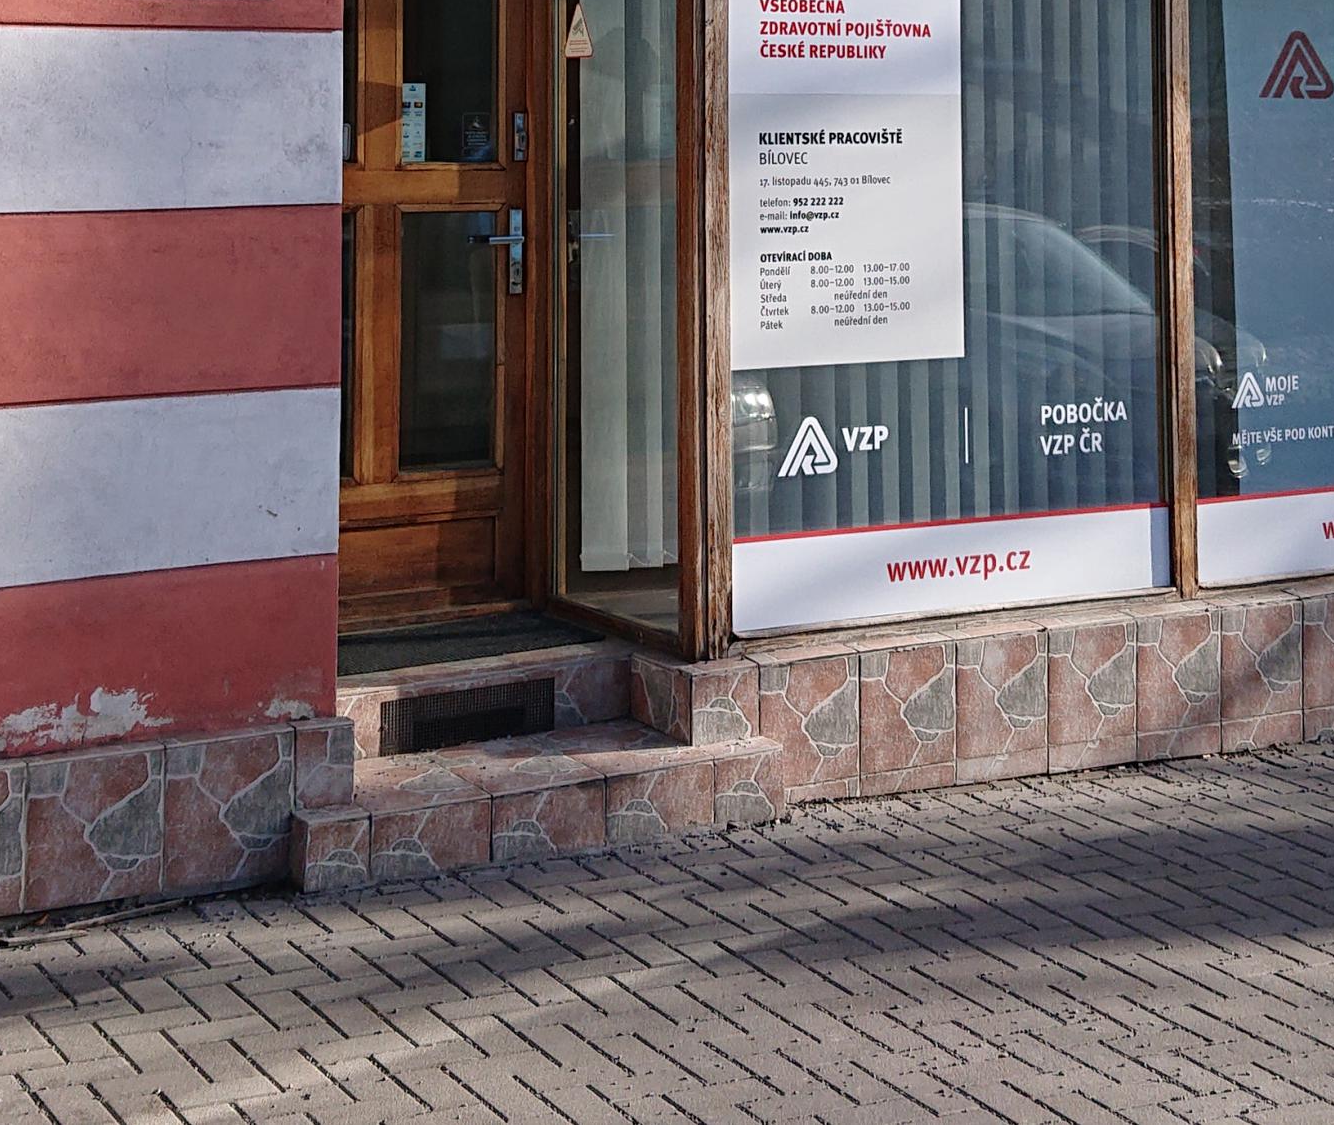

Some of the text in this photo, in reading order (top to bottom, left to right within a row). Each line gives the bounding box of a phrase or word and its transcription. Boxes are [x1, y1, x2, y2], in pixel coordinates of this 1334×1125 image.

[760, 19, 931, 39] ZDRAVOTNÍ POJIŠŤOVNA
[760, 40, 887, 59] ČESKÉ REPUBLIKY
[759, 128, 903, 145] KLIENTSKÉ PRACOVIŠTĚ
[759, 151, 808, 165] BÍLOVEC
[759, 178, 770, 188] 17.
[772, 176, 811, 187] listopadu
[834, 177, 848, 187] 743
[862, 175, 891, 185] Bílovec
[759, 196, 844, 208] telefon: 952 222 222
[759, 210, 840, 222] e-mail: info@vzp.cz
[760, 225, 809, 235] www.vzp.cz
[760, 250, 832, 263] OTEVÍRACÍ DOBA
[760, 265, 791, 276] Pondělí
[760, 280, 782, 291] Úterý
[760, 290, 888, 303] Středa neúřední den
[760, 305, 789, 317] Čtvrtek
[760, 315, 888, 330] Pátek neúřední den
[1265, 375, 1299, 394] MOJE
[1266, 394, 1285, 406] VZP
[1040, 396, 1128, 426] POBOČKA
[841, 425, 889, 452] VZP
[1040, 427, 1103, 456] VZP ČR
[1232, 429, 1262, 446] MĚJTE
[1263, 425, 1283, 443] VŠE
[1284, 427, 1306, 441] POD
[886, 549, 1032, 583] www.vzp.cz
